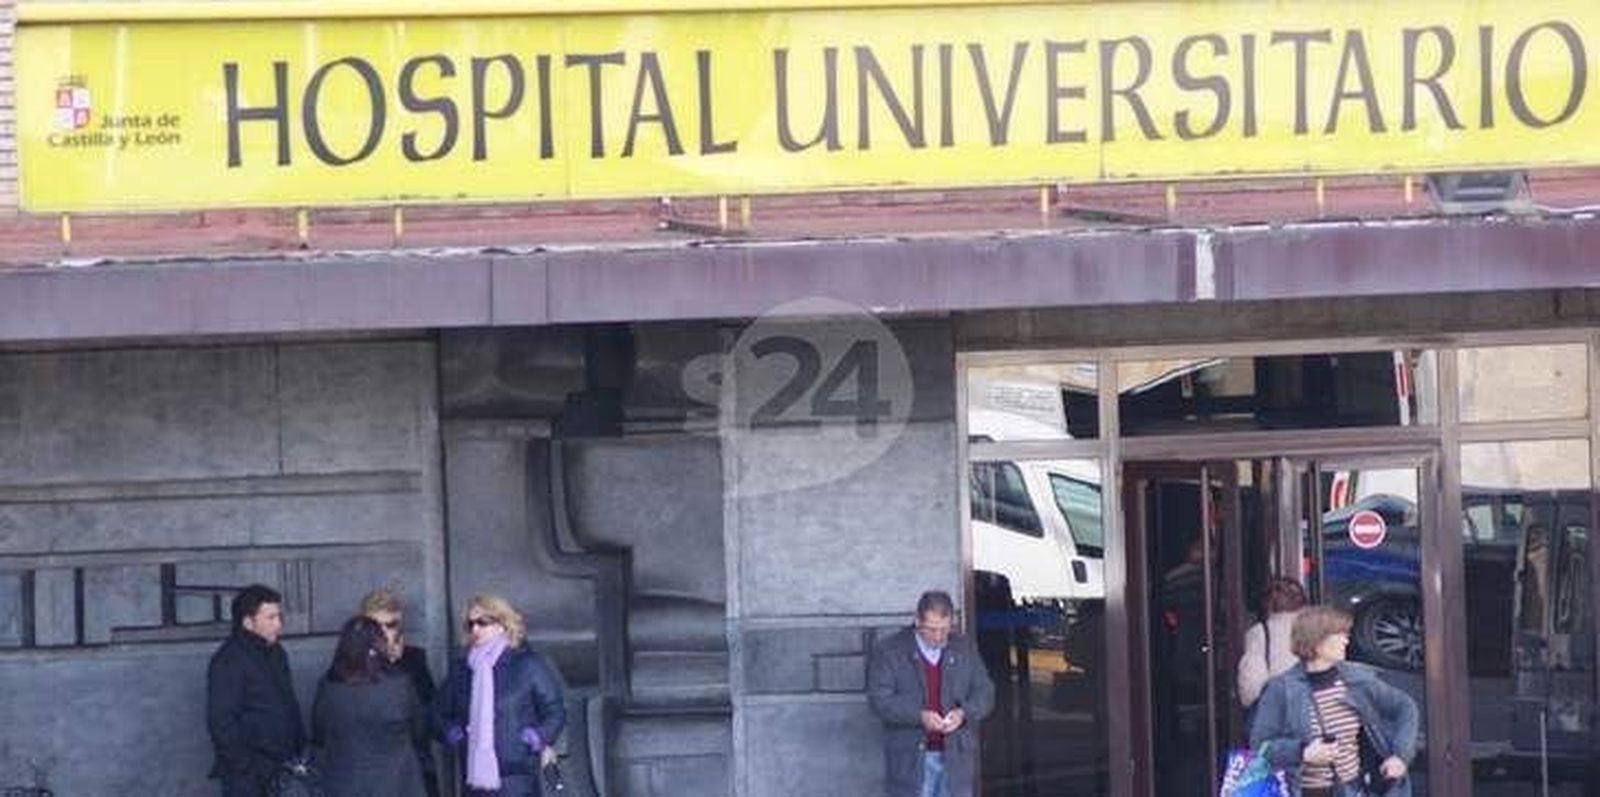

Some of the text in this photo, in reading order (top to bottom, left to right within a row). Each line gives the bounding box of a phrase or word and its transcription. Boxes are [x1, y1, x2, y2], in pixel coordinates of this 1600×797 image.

[223, 21, 1588, 168] HOSPITAL UNIVERSITARIO
[101, 112, 180, 129] Junta de
[48, 129, 181, 149] Castilla y León
